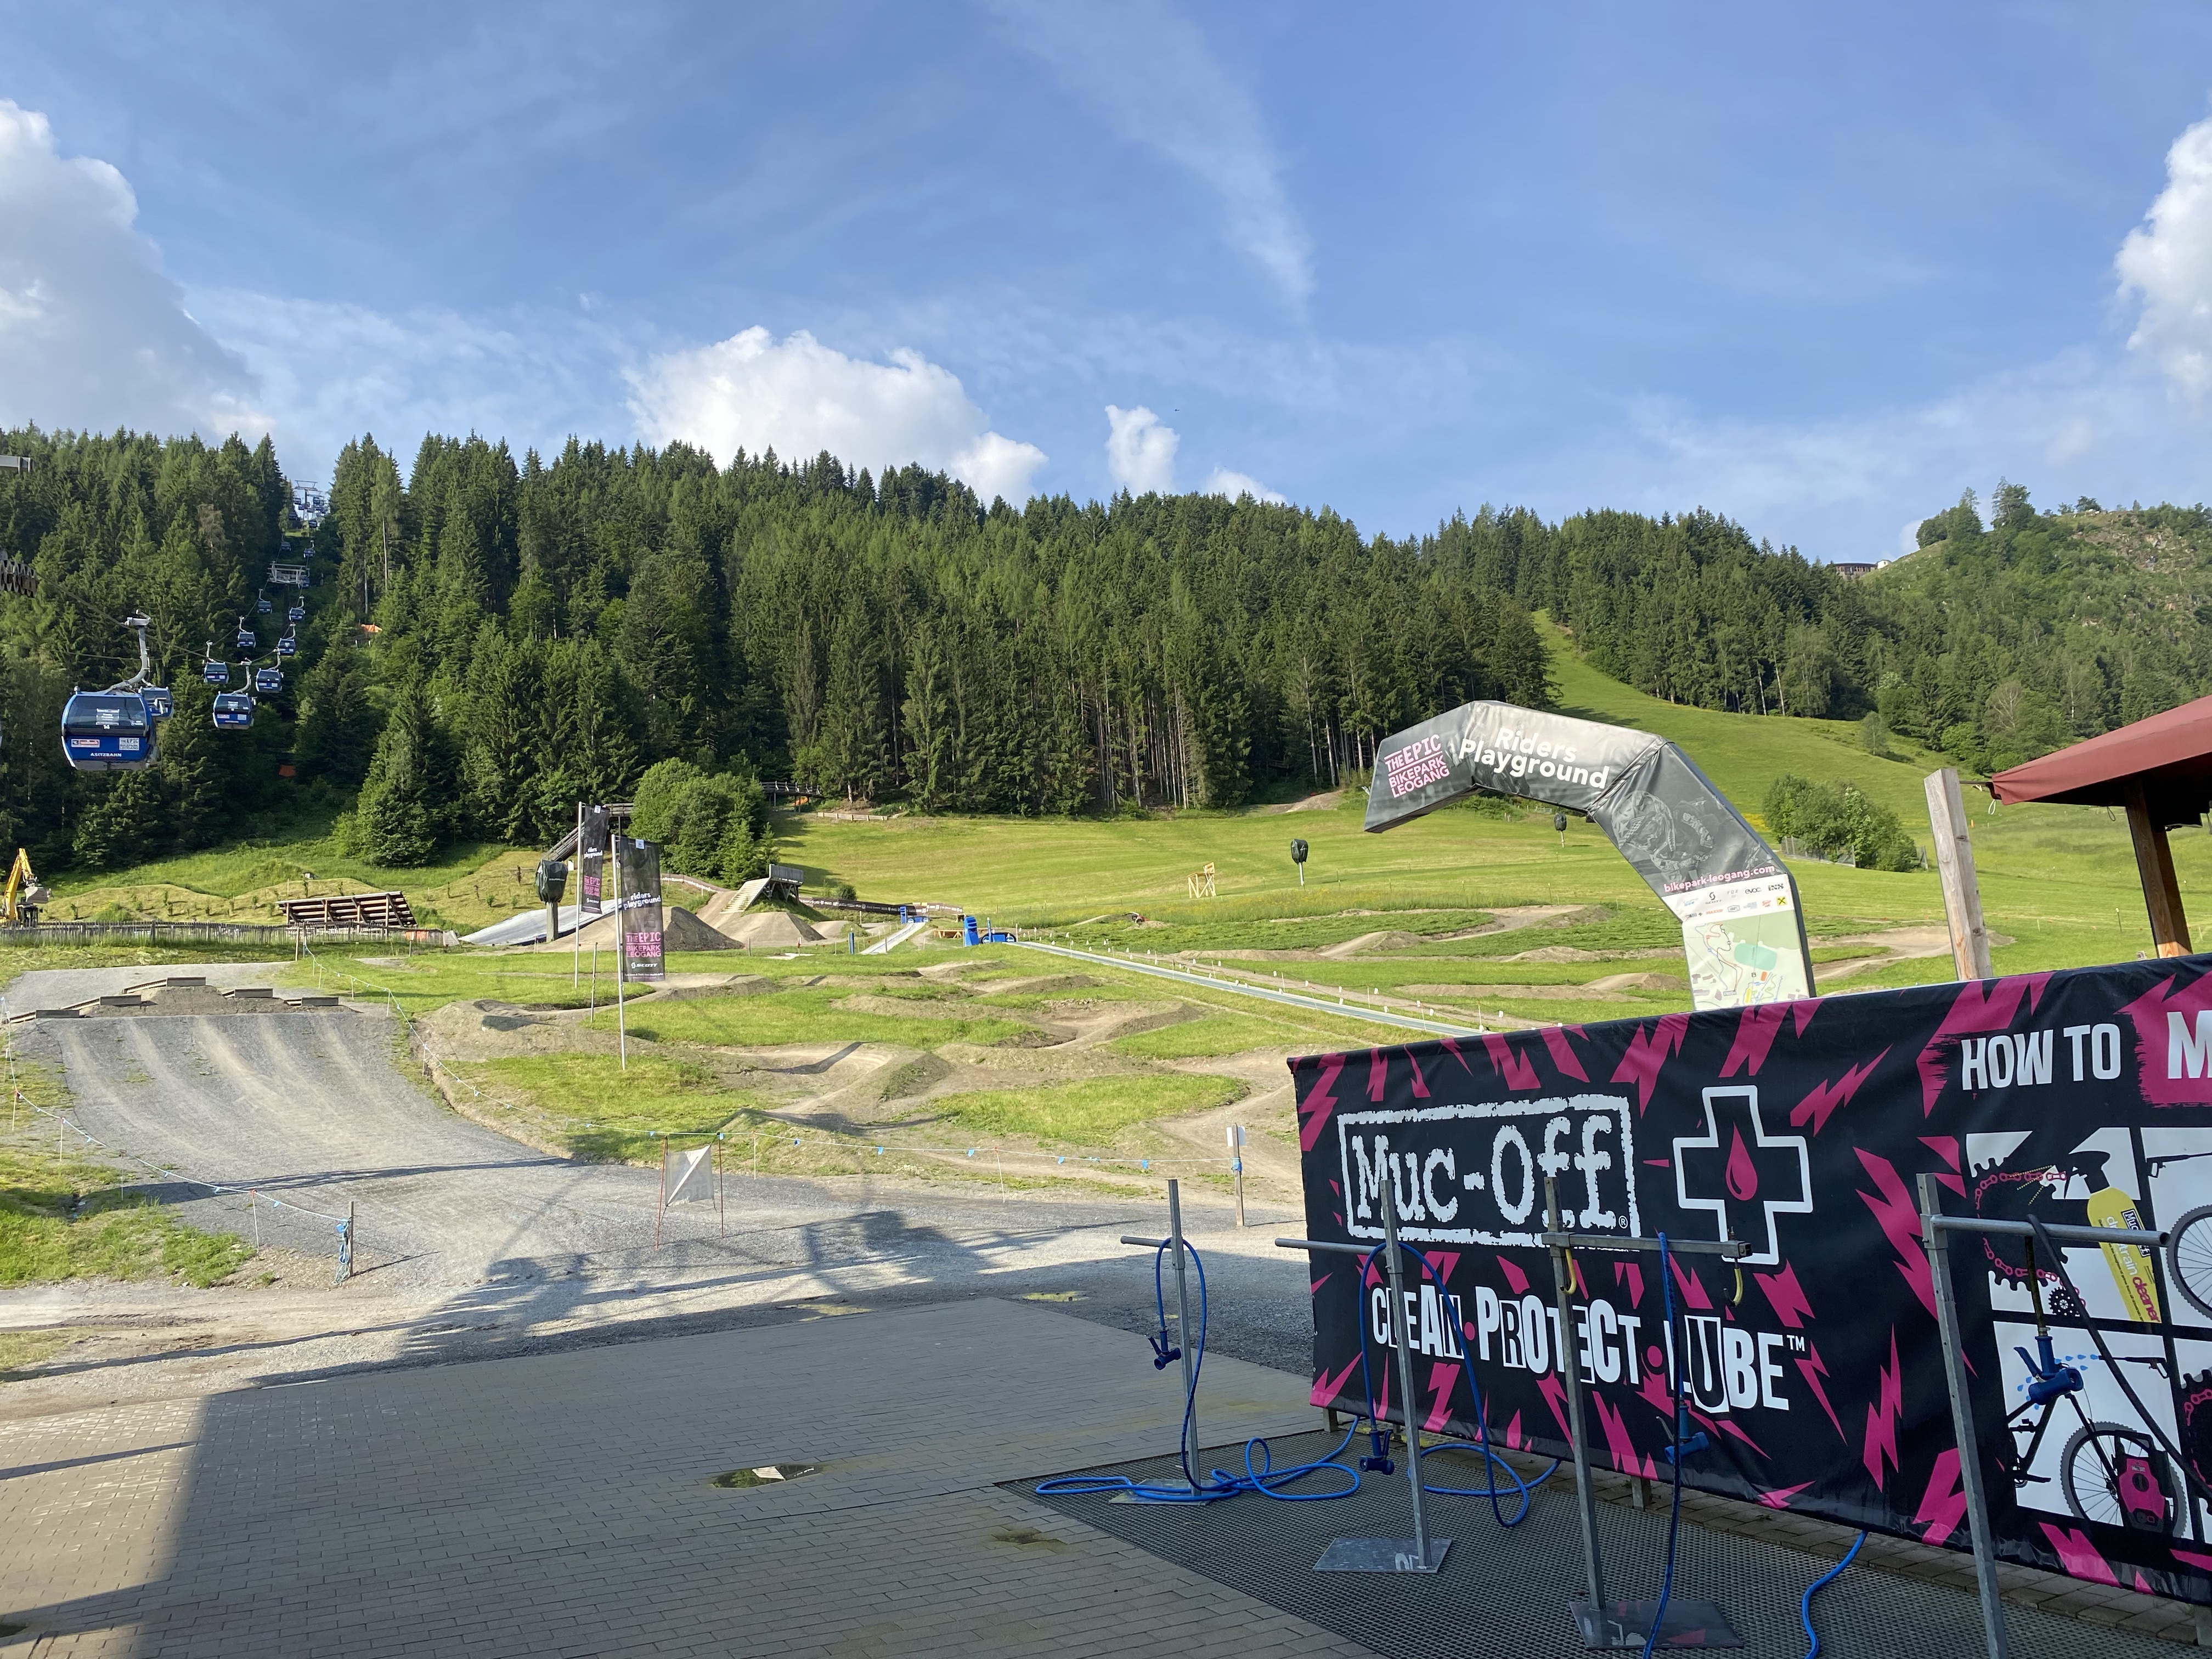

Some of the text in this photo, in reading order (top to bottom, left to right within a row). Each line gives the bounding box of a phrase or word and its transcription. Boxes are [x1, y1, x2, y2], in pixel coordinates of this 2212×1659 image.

[1385, 734, 1441, 772] THE EPIC
[1494, 727, 1578, 763] Riders
[1388, 755, 1447, 788] BIKEPARK
[1458, 738, 1610, 789] Playground
[1391, 765, 1450, 798] LEOGANG
[1663, 865, 1775, 893] bikepark-leogang.com
[623, 895, 661, 911] playground
[630, 892, 651, 901] riders
[639, 932, 661, 943] EPIC
[1961, 1029, 2054, 1090] HOW
[2063, 1023, 2121, 1081] TO
[2132, 1277, 2161, 1323] cleaner
